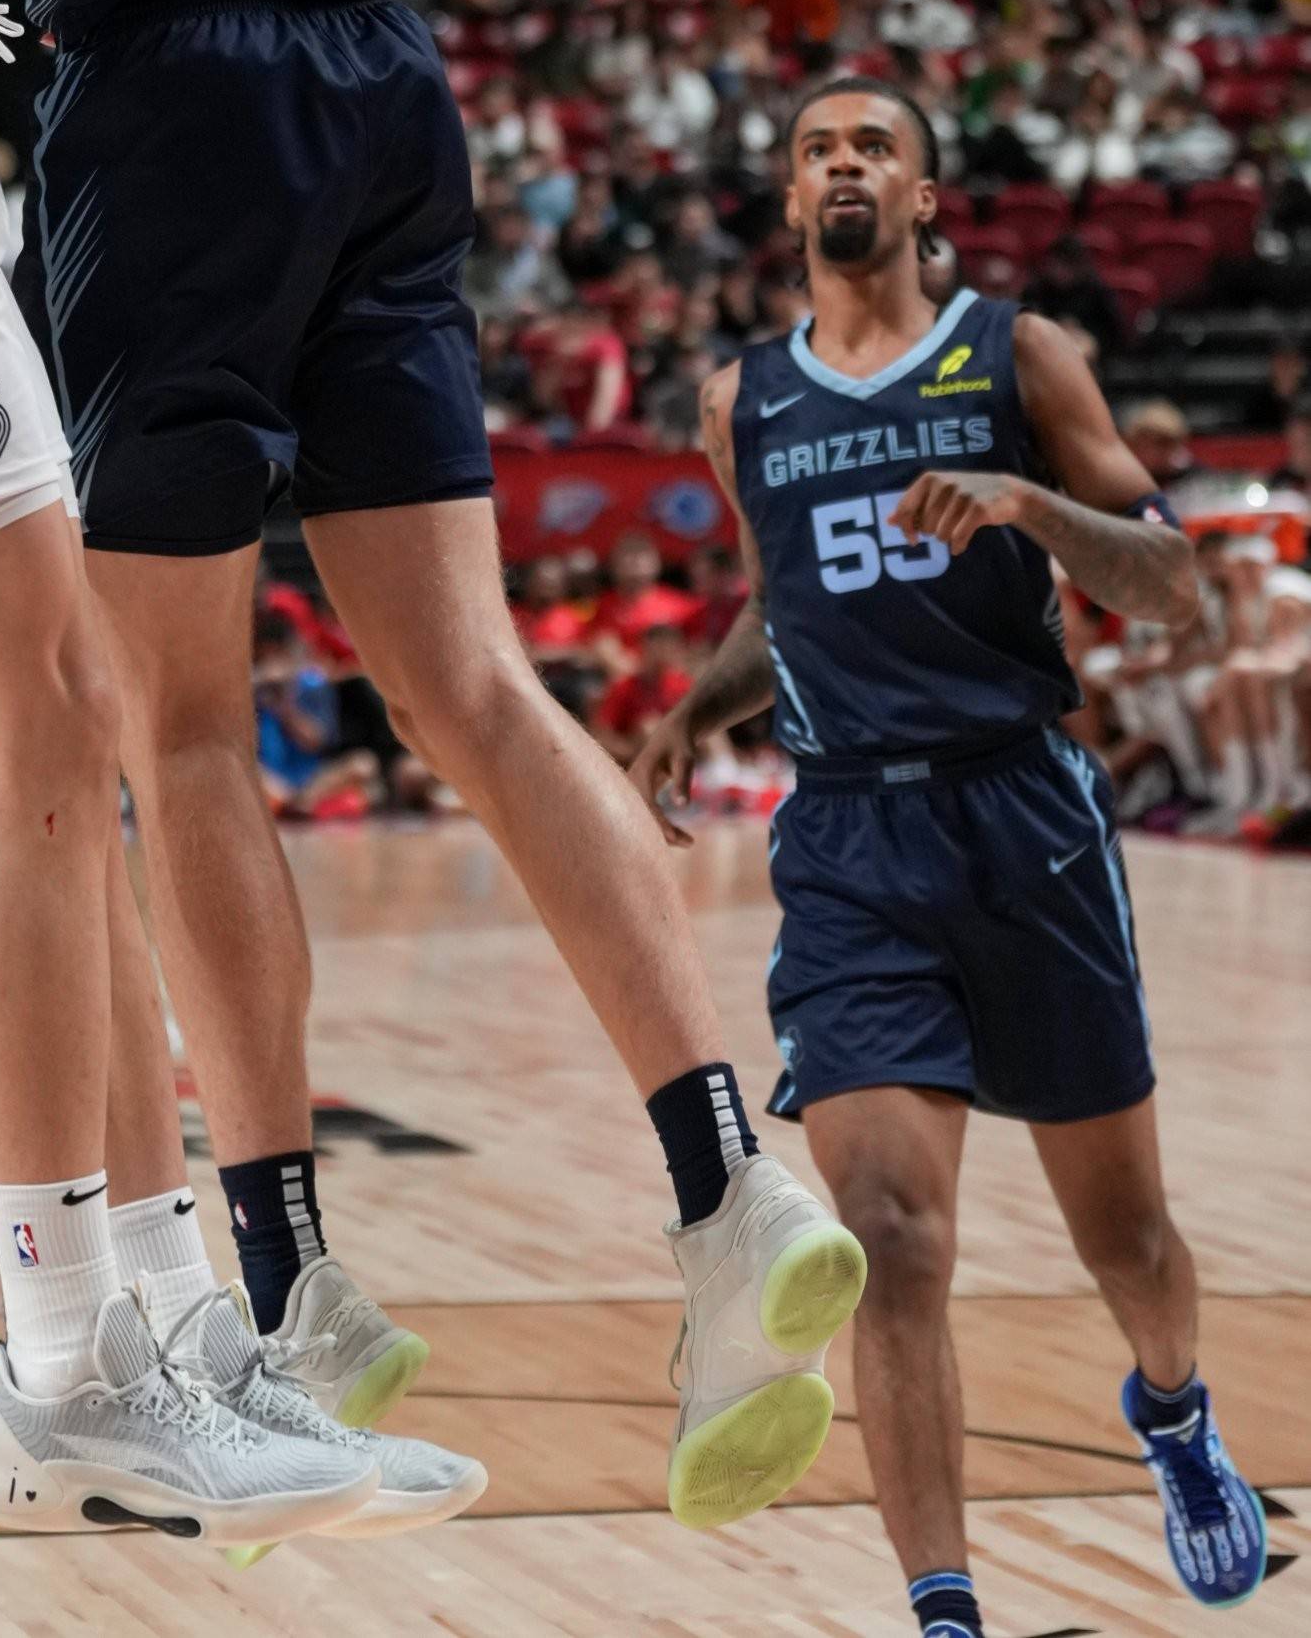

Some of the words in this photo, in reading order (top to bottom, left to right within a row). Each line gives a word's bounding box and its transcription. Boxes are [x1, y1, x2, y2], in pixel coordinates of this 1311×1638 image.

[919, 377, 992, 398] Robinhood
[764, 416, 993, 487] GRIZZLIES
[811, 490, 951, 594] 55
